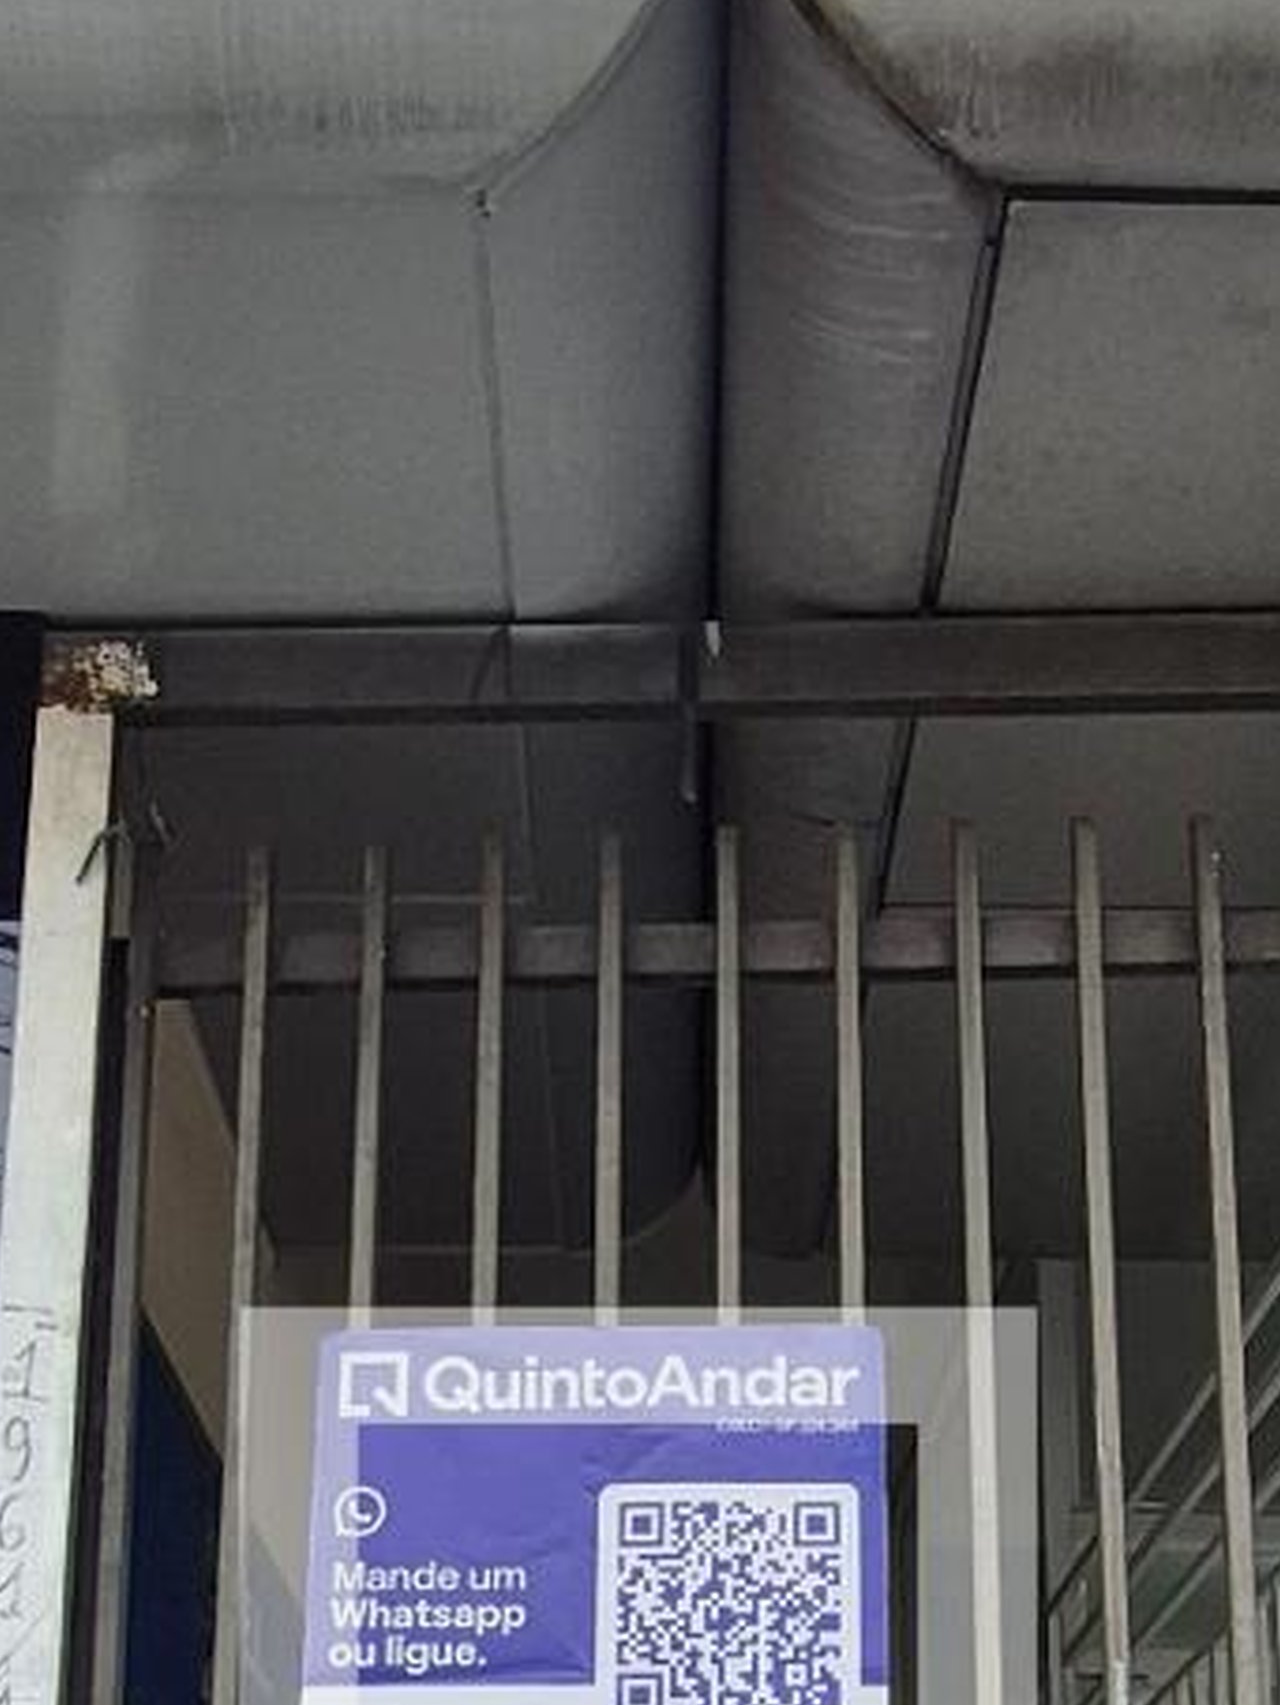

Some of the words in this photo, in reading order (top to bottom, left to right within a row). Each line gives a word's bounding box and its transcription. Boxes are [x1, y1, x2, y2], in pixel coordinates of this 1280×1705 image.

[423, 1354, 861, 1413] QuintoAndar
[333, 1560, 461, 1591] Mande
[469, 1565, 527, 1591] um
[330, 1597, 527, 1637] Whatsapp
[328, 1642, 377, 1668] ou
[385, 1634, 488, 1676] ligue.
